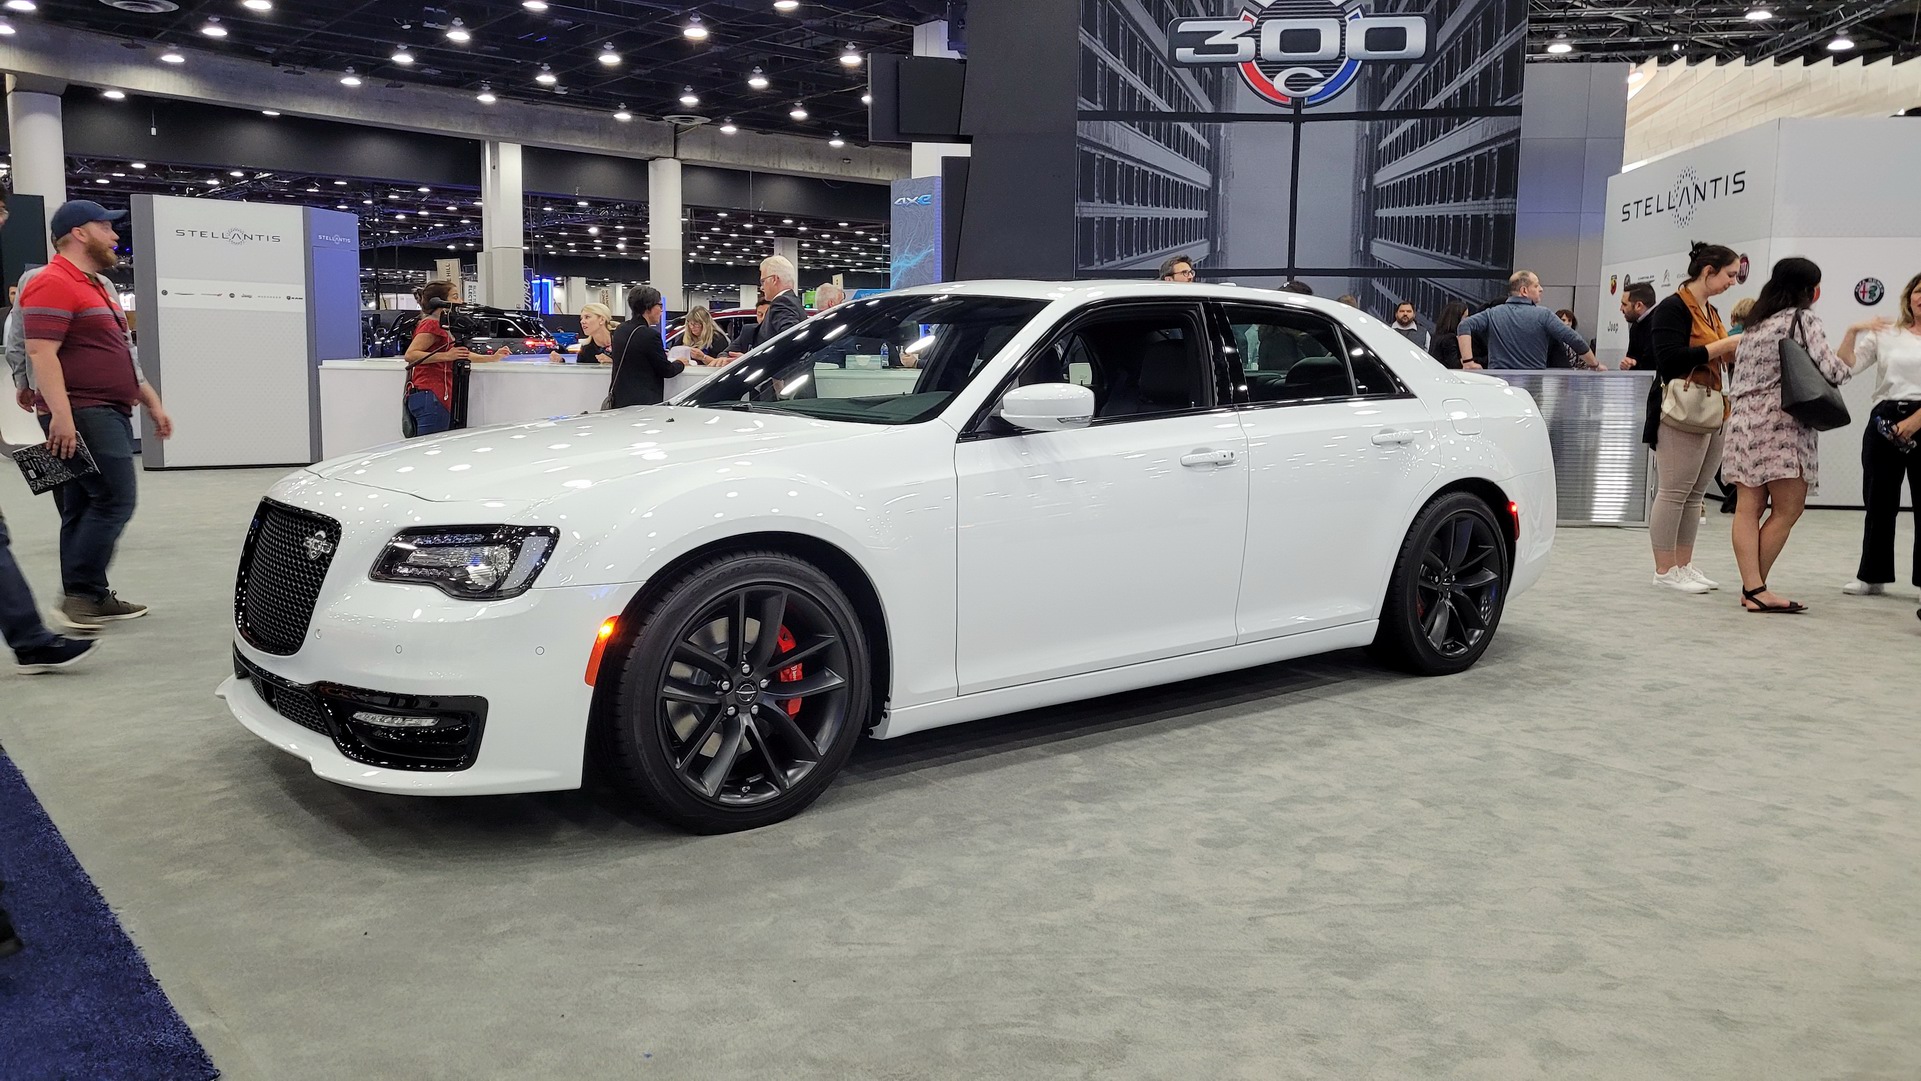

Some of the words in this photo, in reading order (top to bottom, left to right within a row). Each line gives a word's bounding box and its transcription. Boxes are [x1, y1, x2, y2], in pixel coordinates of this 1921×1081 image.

[1175, 16, 1427, 63] 300
[1273, 66, 1325, 98] C
[1621, 170, 1746, 223] STELLANTIS
[175, 229, 281, 243] STELLANTIS
[318, 234, 351, 244] STELLANTIS
